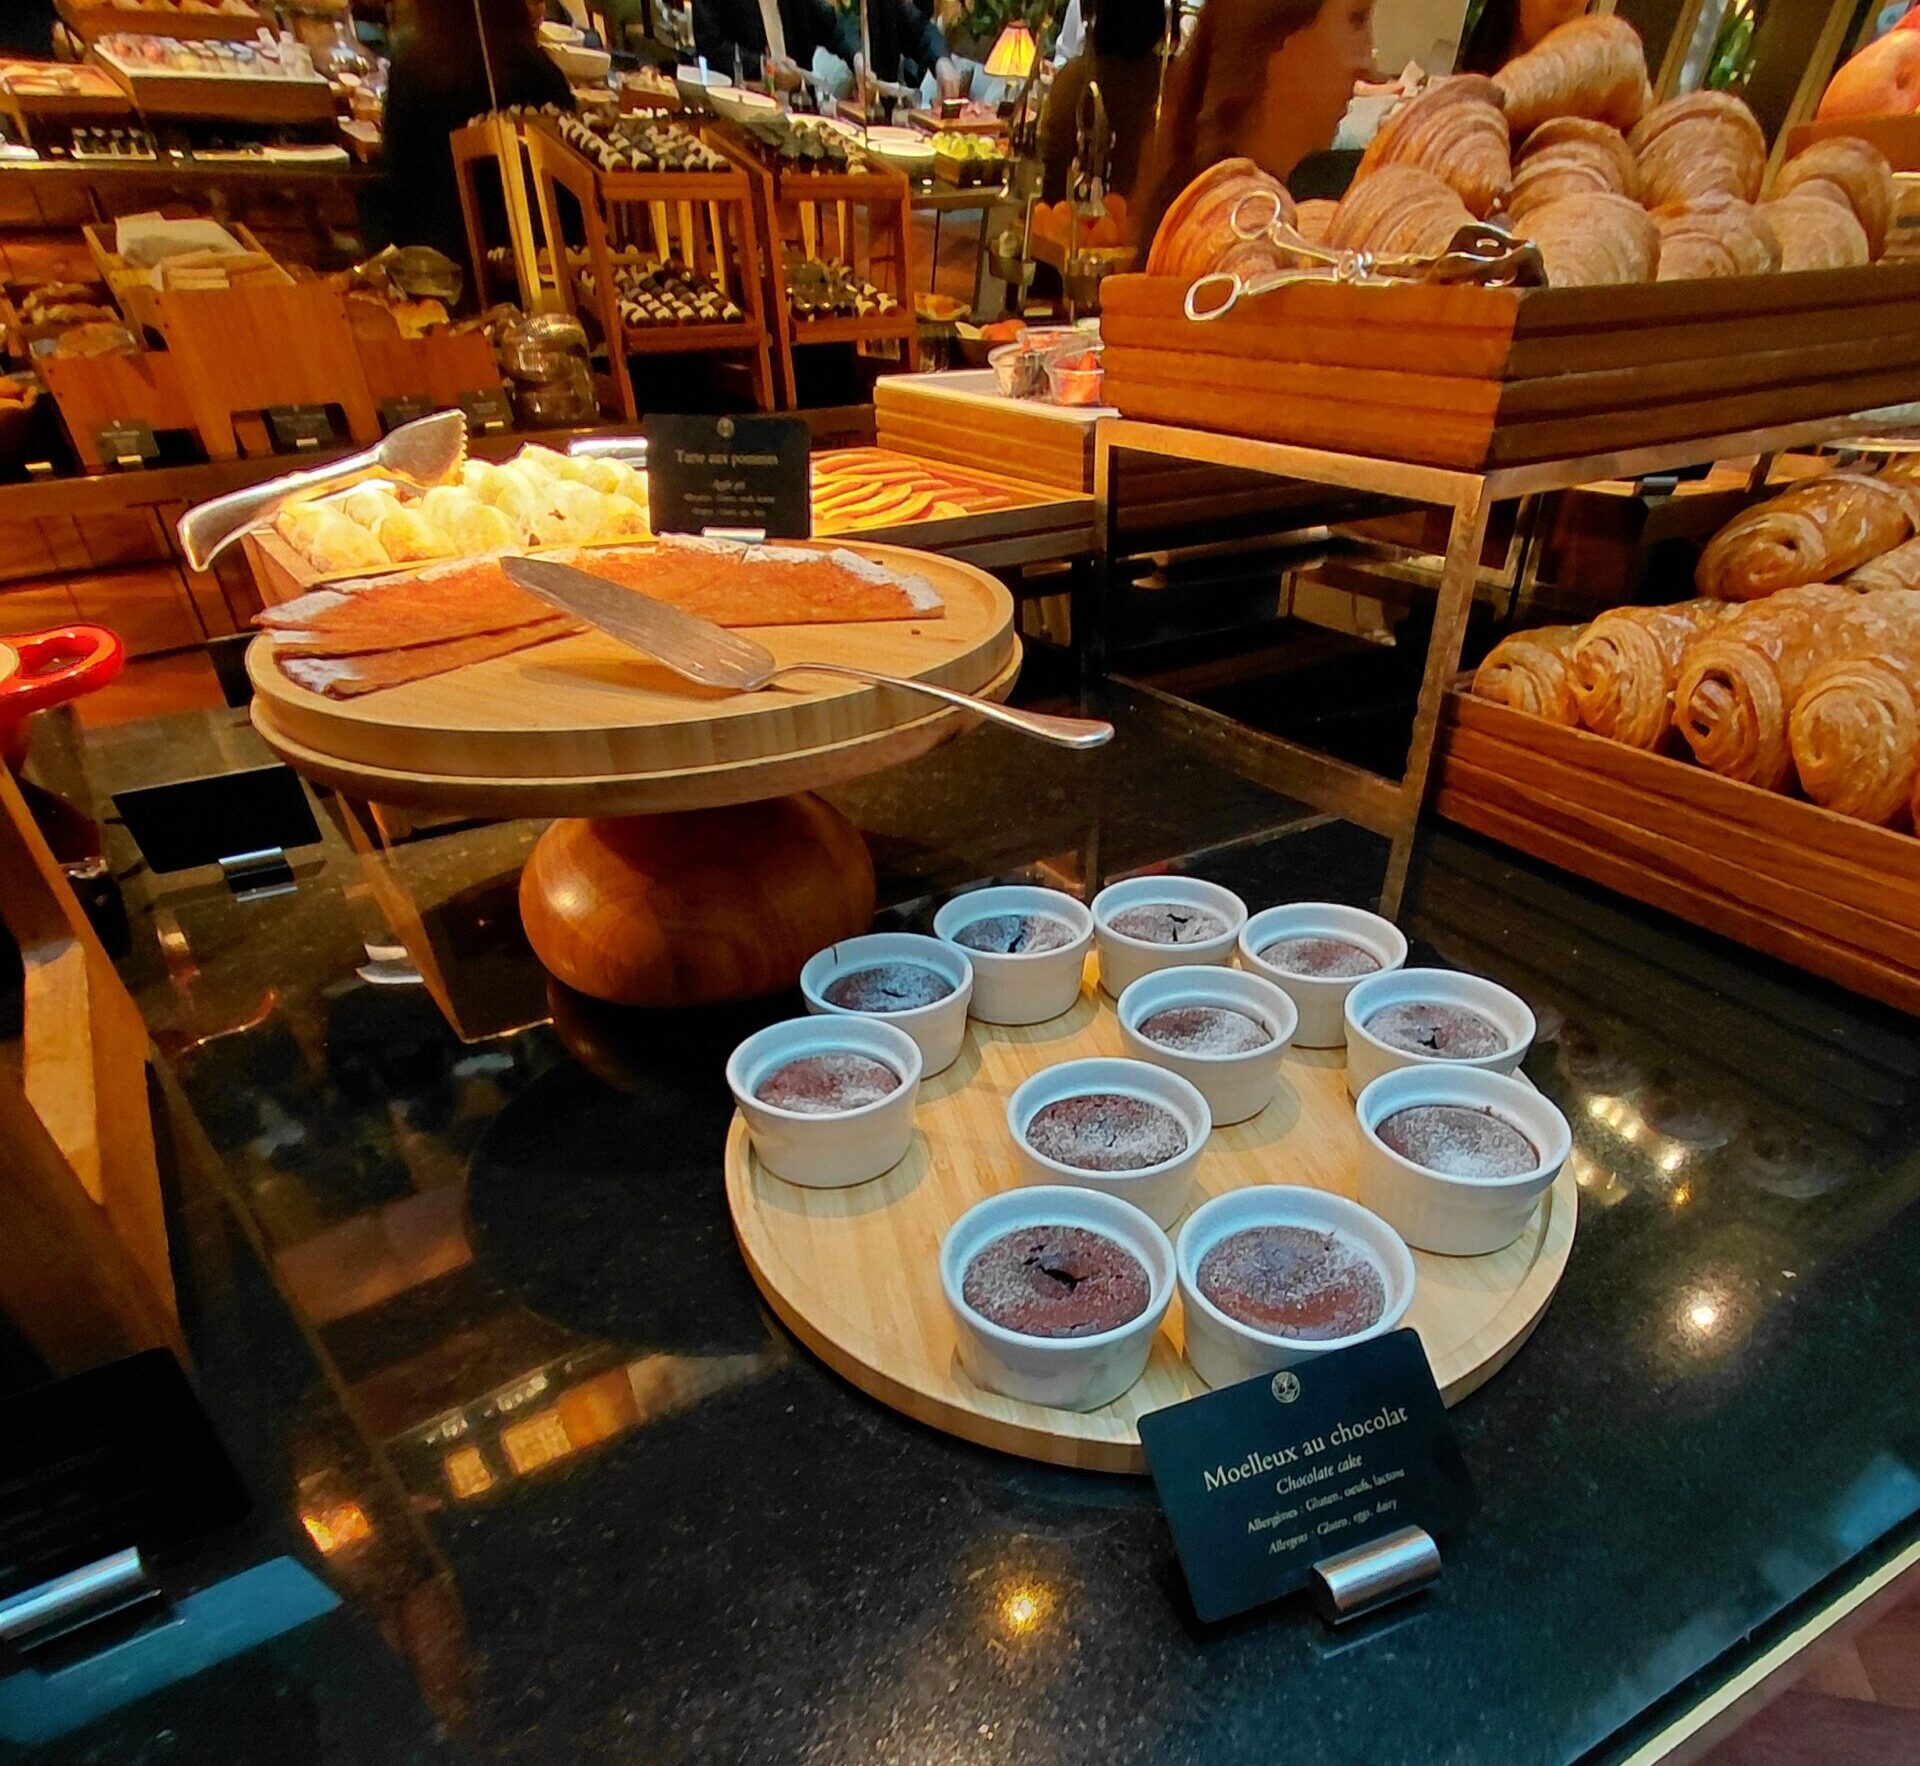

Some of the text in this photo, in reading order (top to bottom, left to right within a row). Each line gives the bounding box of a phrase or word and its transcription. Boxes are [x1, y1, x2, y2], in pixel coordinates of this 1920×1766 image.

[1203, 1407, 1408, 1492] Moelleux au chocolat
[1276, 1453, 1363, 1495] Chocolate cake
